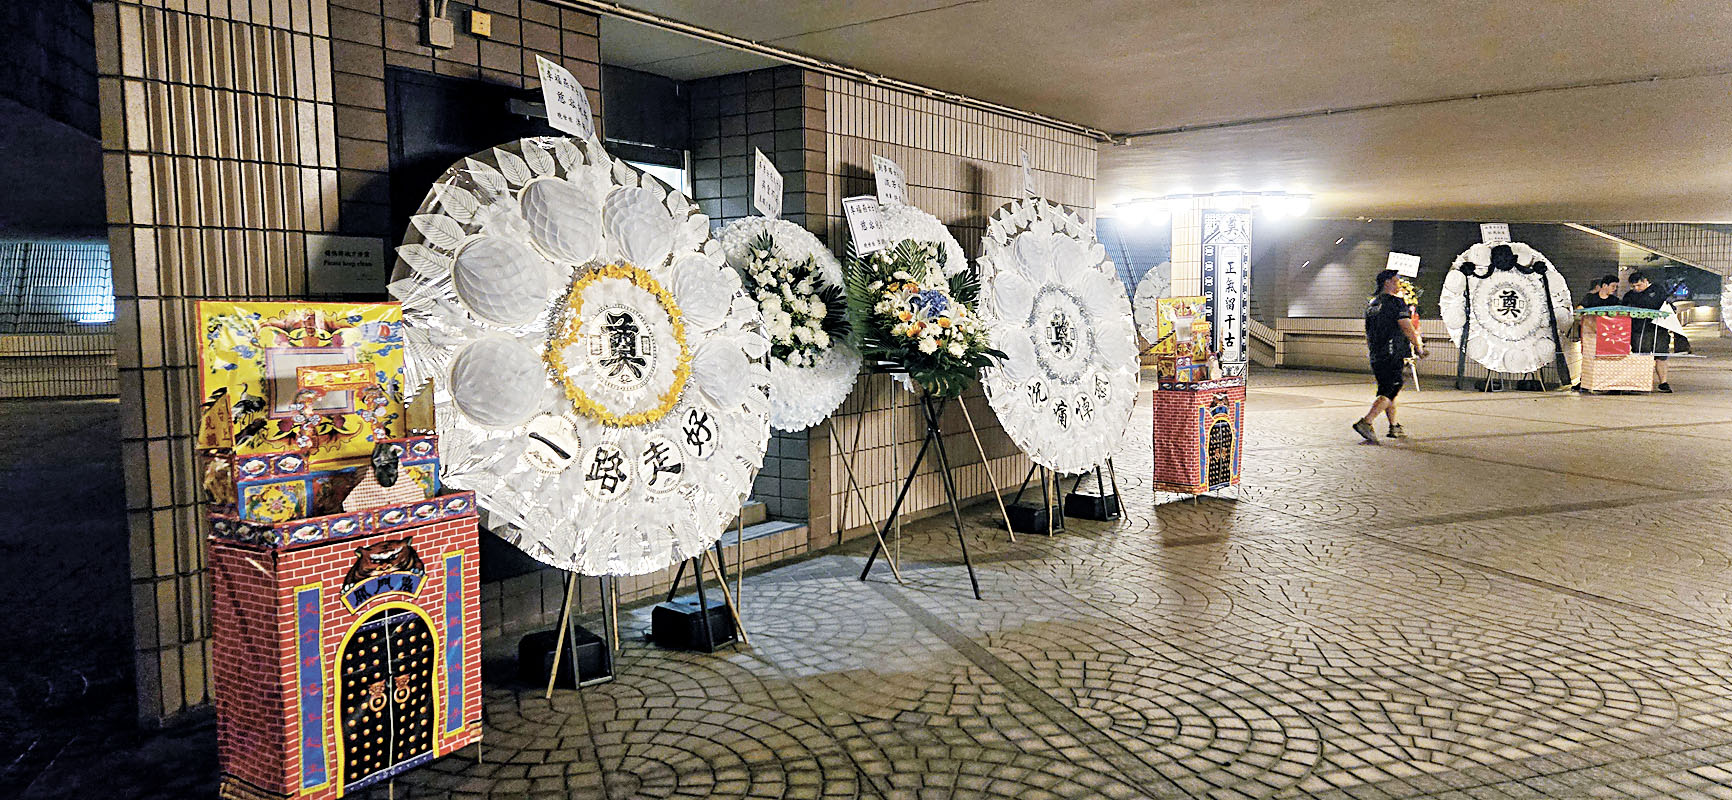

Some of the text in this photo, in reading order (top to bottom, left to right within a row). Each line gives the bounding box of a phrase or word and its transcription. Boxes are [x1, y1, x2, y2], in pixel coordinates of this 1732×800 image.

[1224, 261, 1238, 348] 正氣留千古
[1496, 289, 1521, 318] 奠
[600, 312, 647, 379] 奠
[1050, 312, 1074, 355] 奠
